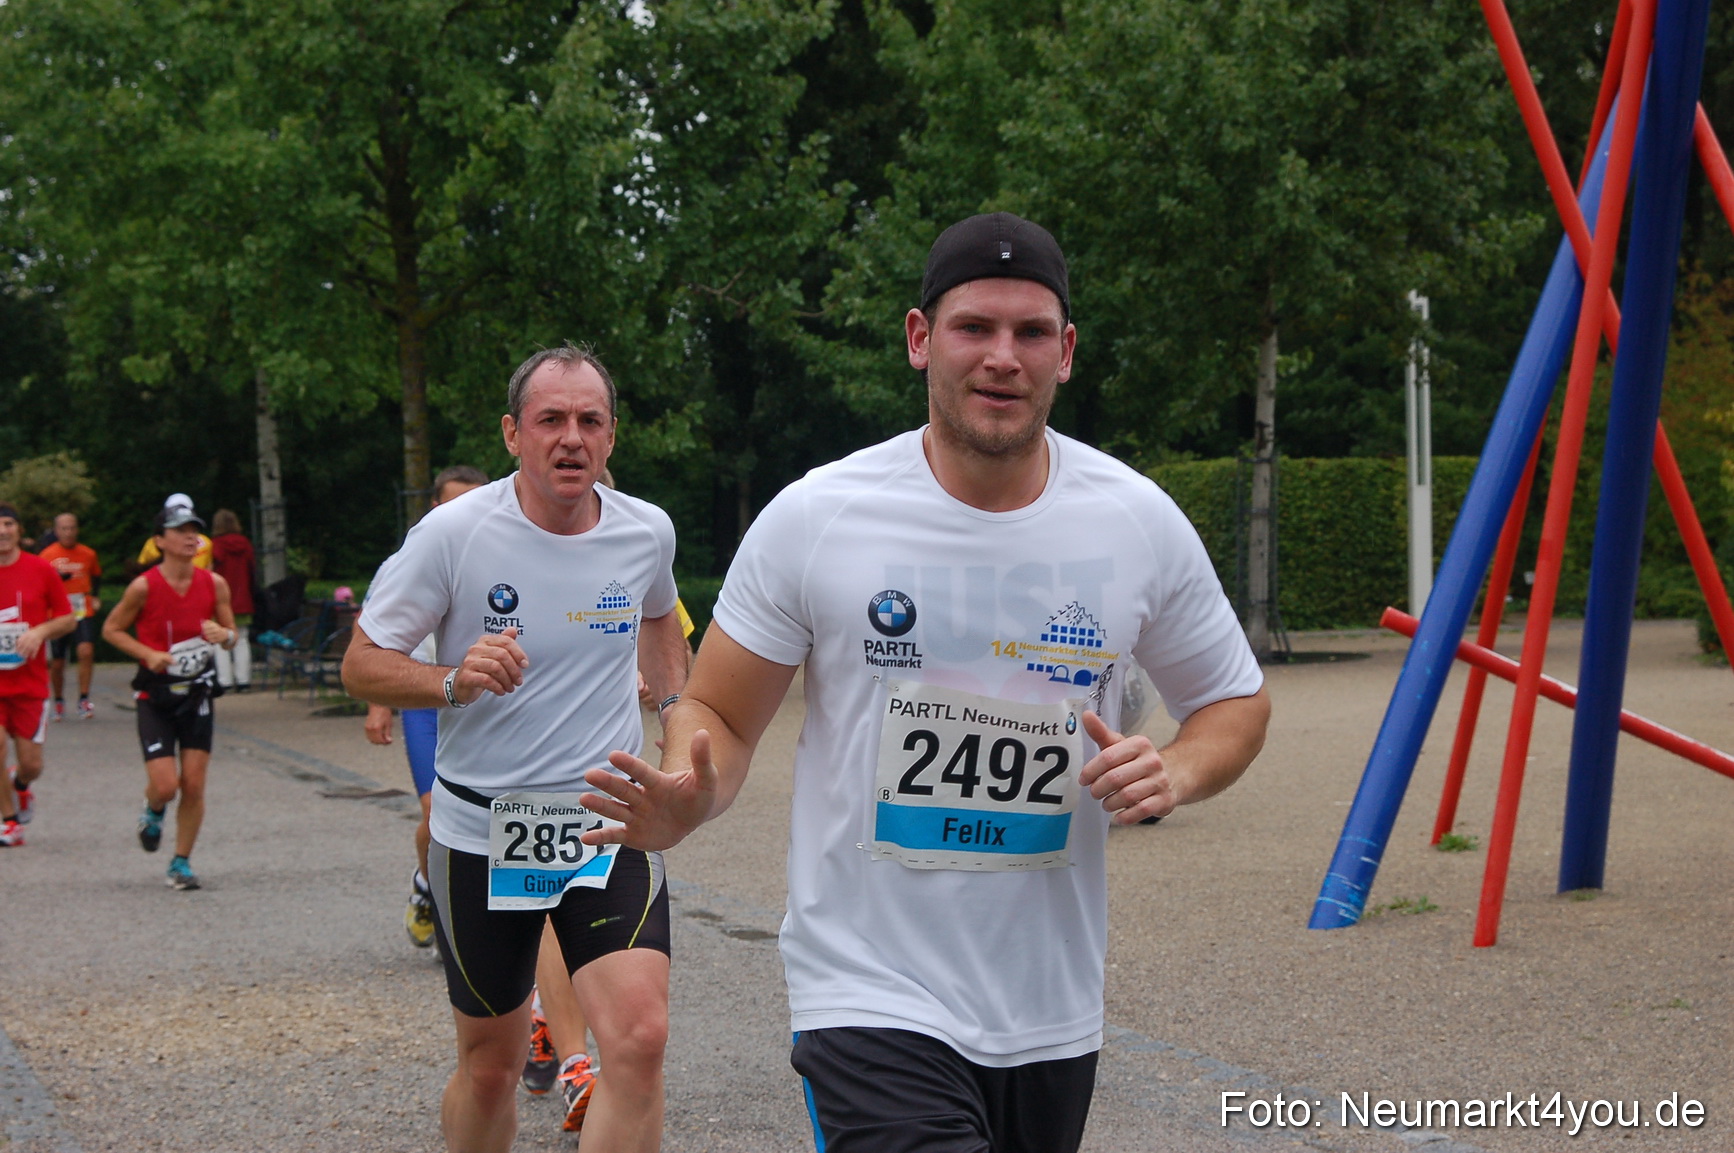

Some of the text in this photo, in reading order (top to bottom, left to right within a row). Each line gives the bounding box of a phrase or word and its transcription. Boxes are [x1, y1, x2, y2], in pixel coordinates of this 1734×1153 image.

[872, 591, 913, 608] BMW
[484, 616, 524, 628] PARTL
[566, 611, 587, 623] 14.
[864, 640, 923, 658] PARTL
[990, 640, 1024, 660] 14.
[1019, 642, 1078, 656] Neumarkter
[866, 655, 922, 669] Neumarkt
[889, 698, 1060, 736] PARTL Neumarkt
[897, 729, 1070, 805] 2492
[882, 789, 891, 801] B
[494, 803, 538, 816] PARTL
[942, 817, 1007, 846] Felix
